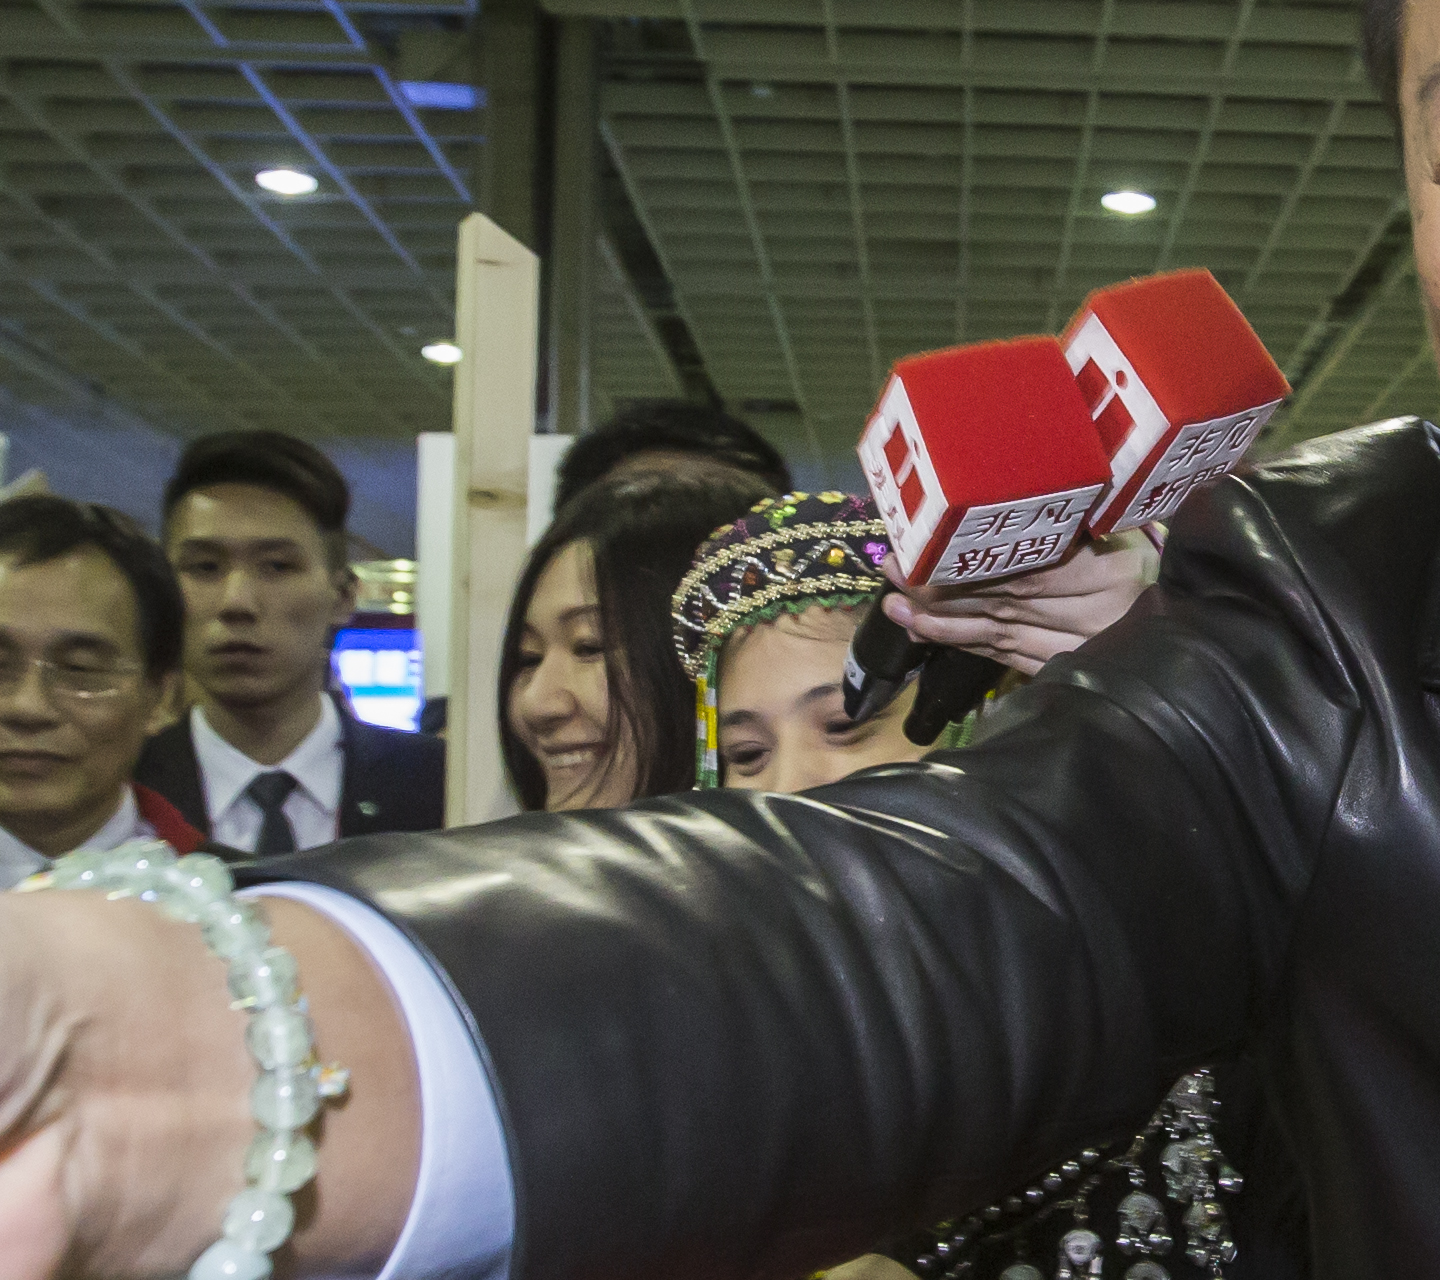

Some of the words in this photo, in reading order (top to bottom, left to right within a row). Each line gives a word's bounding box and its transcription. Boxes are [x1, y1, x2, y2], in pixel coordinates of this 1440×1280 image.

[1170, 416, 1258, 471] 非凡
[967, 499, 1074, 541] 非凡
[948, 532, 1067, 579] 新聞
